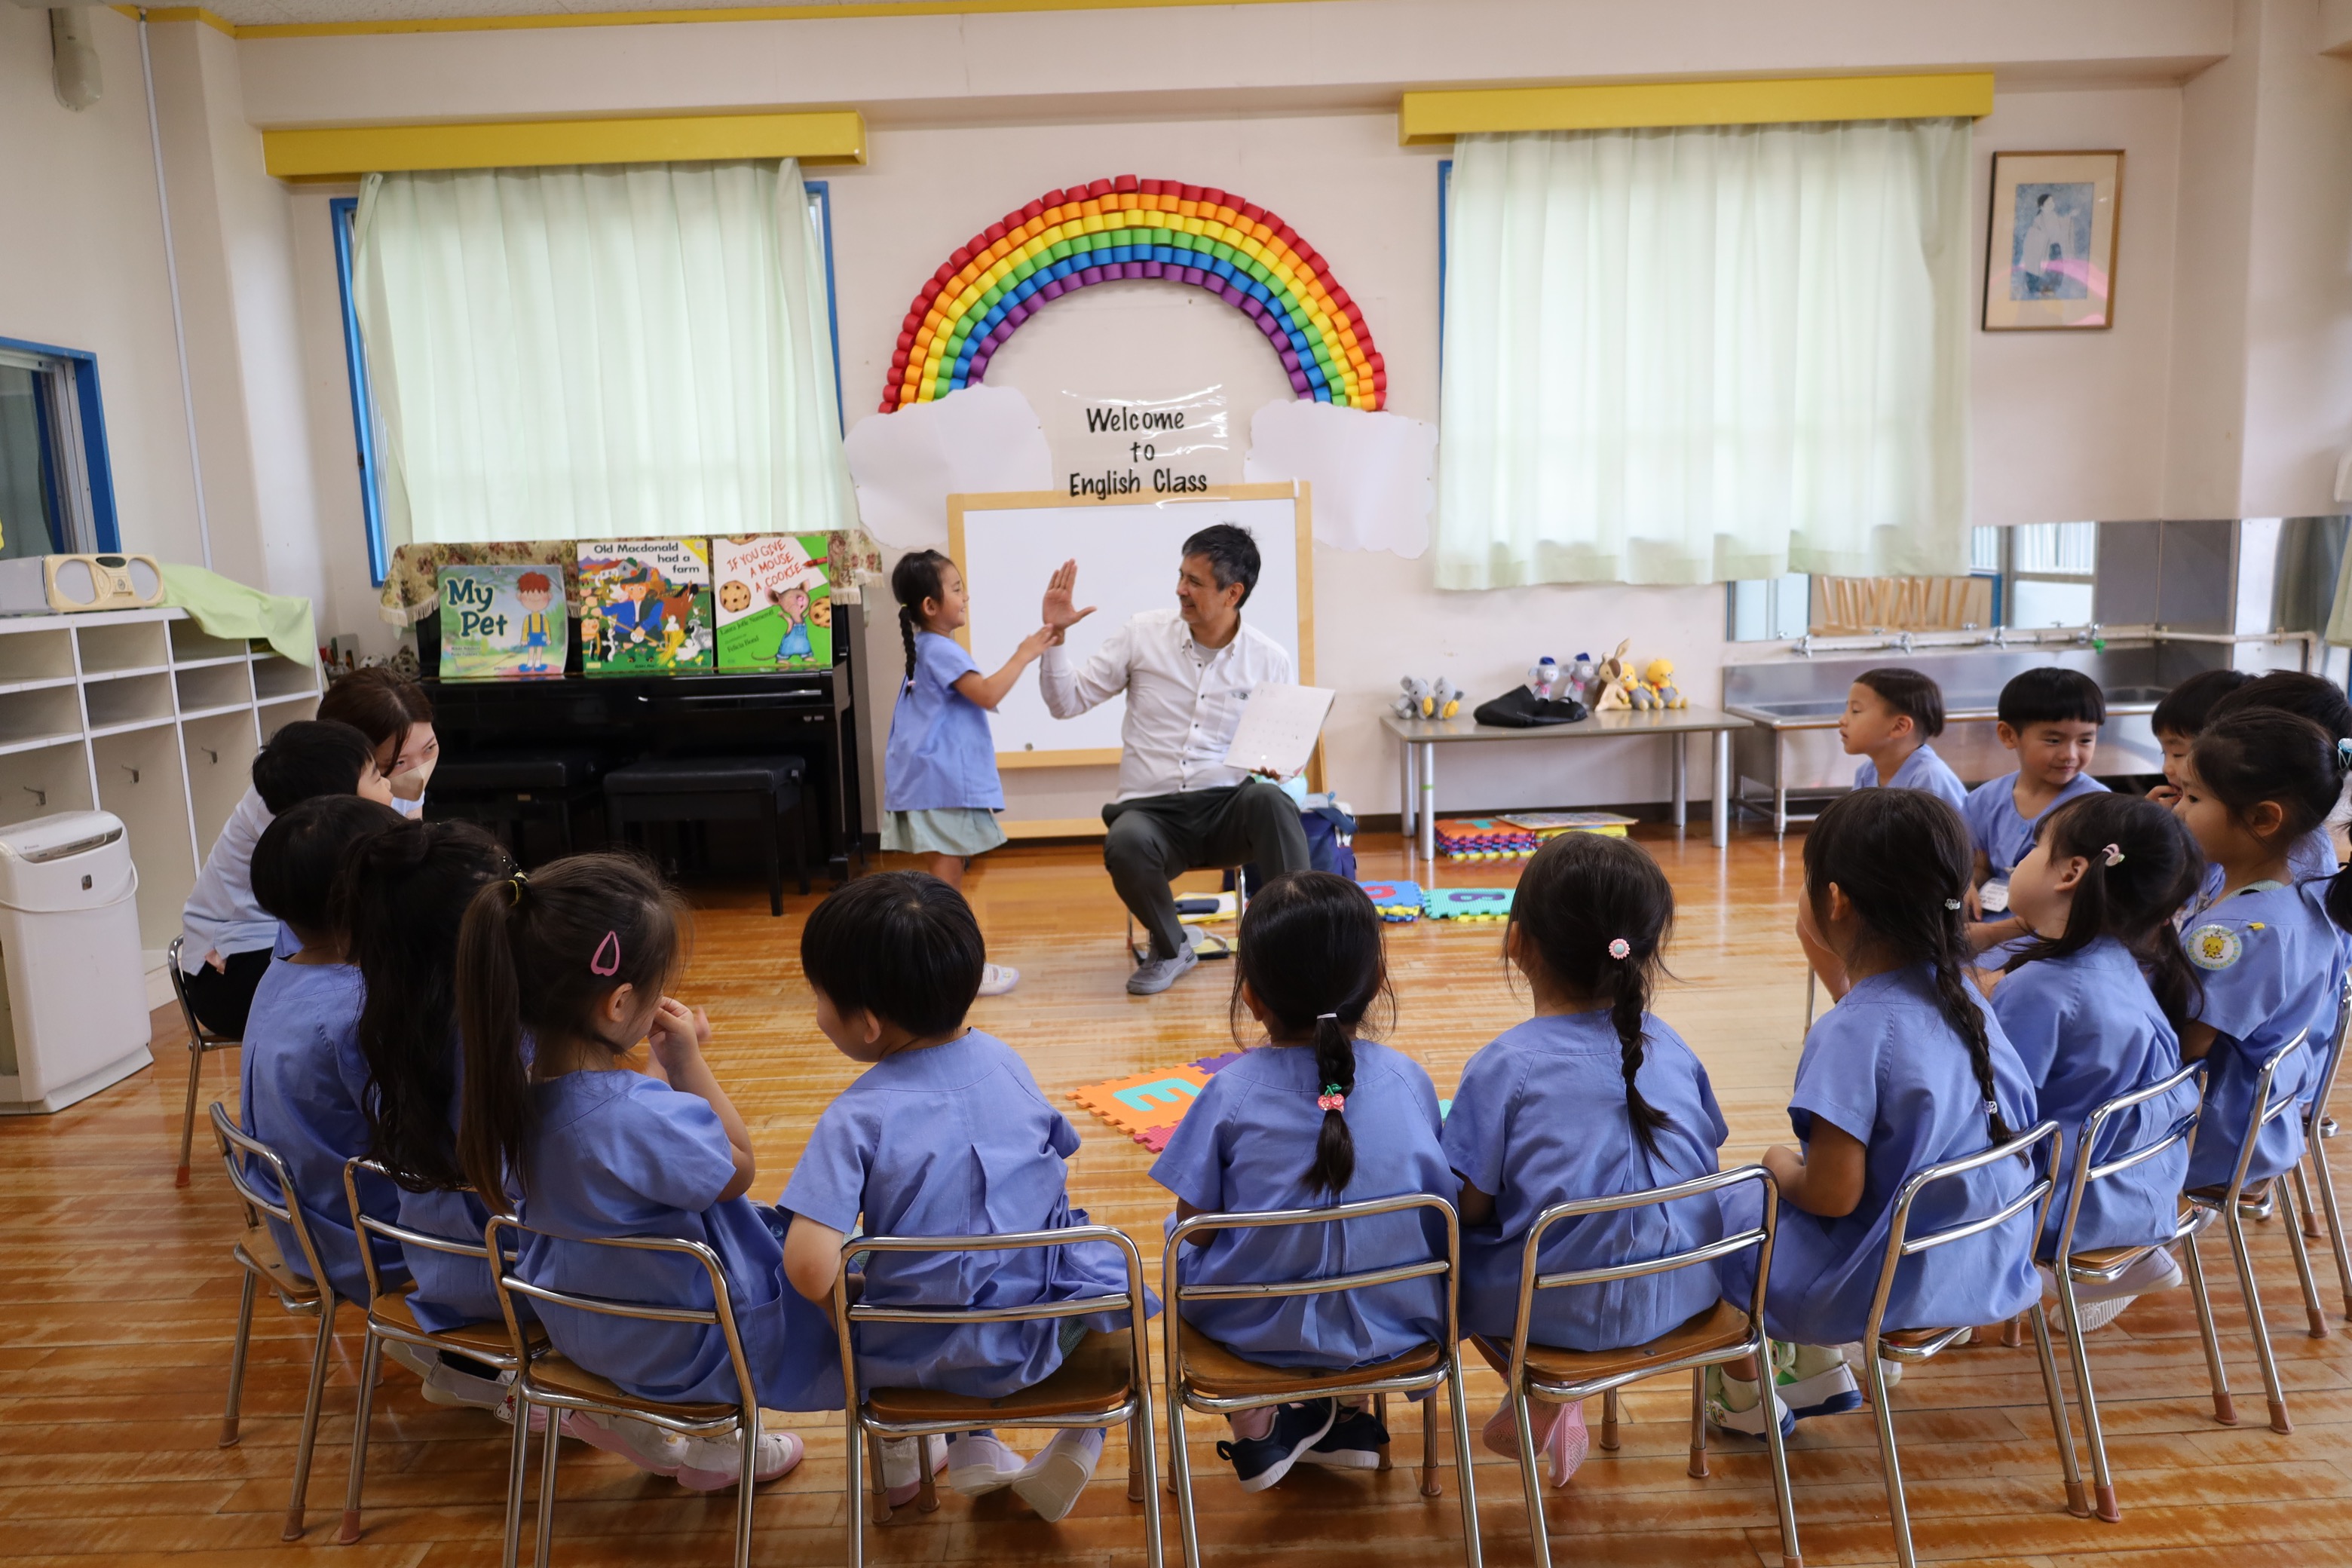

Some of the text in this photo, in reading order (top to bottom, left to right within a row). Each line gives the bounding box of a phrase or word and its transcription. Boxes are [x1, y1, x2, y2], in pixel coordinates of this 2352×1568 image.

[1086, 406, 1184, 433] Welcome
[1130, 442, 1155, 463] to
[1070, 467, 1207, 501] English Class
[594, 543, 678, 553] Old Macdonald
[657, 554, 678, 562] had
[727, 539, 786, 571] IF YOU GIVE
[672, 565, 700, 573] farm
[750, 552, 794, 578] A MOUSE
[755, 562, 802, 593] A COOKIE
[447, 579, 493, 612] My
[461, 611, 507, 637] Pet
[1113, 1078, 1202, 1112] E
